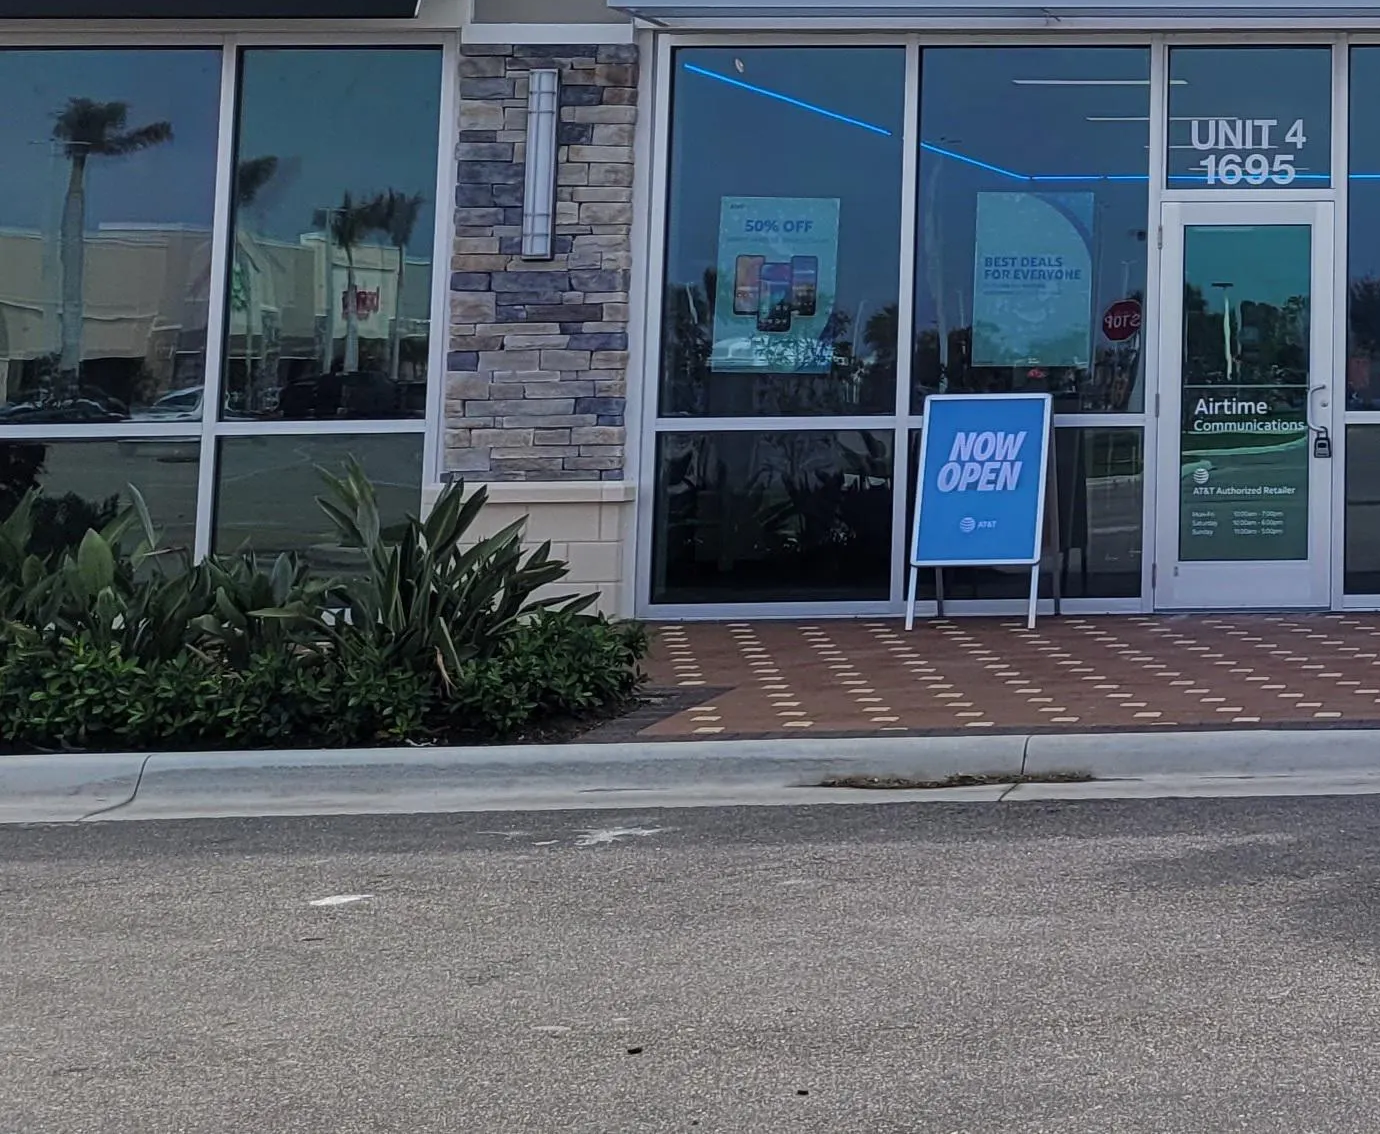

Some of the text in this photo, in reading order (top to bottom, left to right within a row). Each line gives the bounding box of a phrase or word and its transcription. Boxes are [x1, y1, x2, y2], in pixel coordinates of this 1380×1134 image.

[1191, 118, 1307, 150] UNIT 4
[1200, 153, 1296, 185] 1695
[744, 219, 814, 233] 50% OFF
[984, 256, 1063, 267] BEST DEALS
[984, 269, 1082, 280] FOR EVERYONE
[1194, 397, 1268, 415] Airtime
[1193, 418, 1305, 432] Communications
[948, 431, 1028, 461] NOW
[937, 461, 1023, 492] OPEN
[1192, 486, 1296, 495] AT&T Authorized Retailer
[977, 520, 997, 529] AT&T
